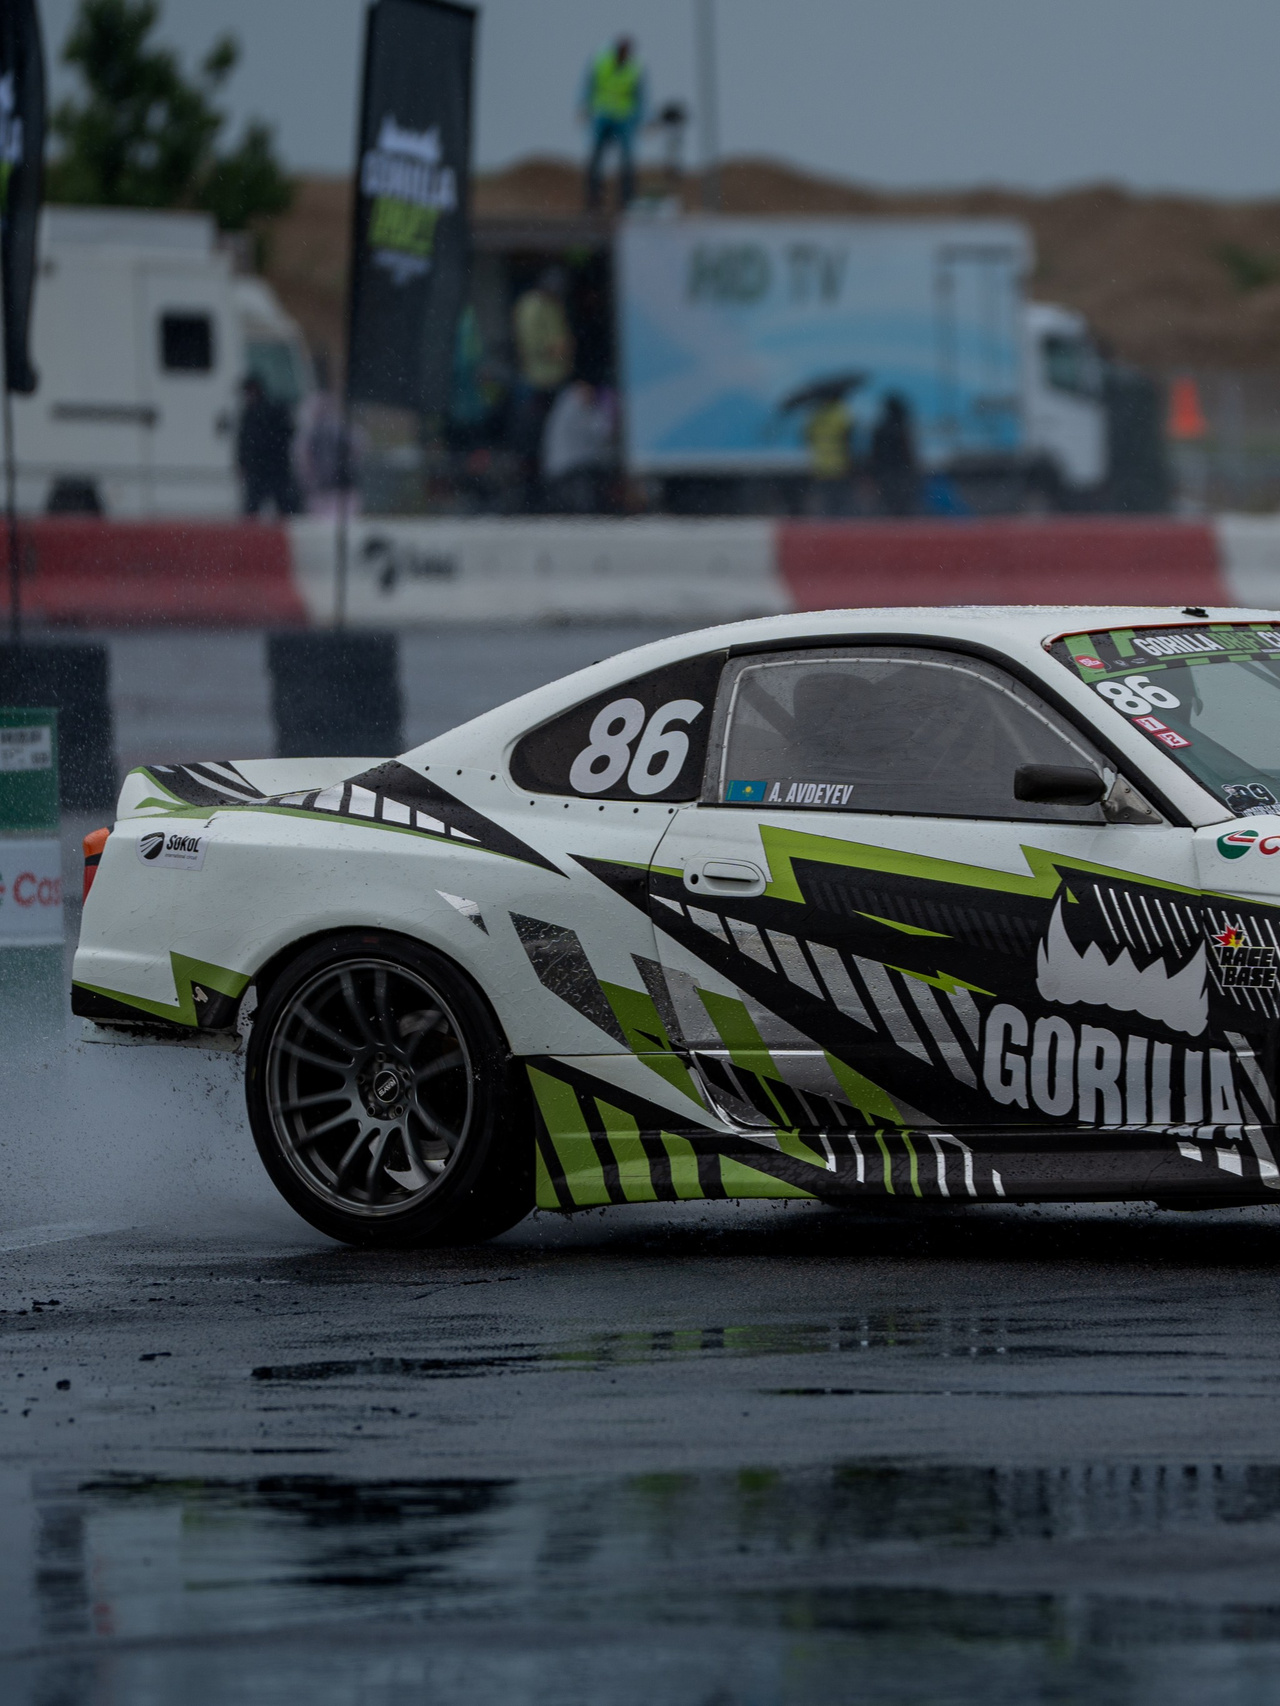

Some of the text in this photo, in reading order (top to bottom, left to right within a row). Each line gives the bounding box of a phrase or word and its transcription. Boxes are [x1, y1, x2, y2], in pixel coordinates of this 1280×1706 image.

[1133, 633, 1226, 657] GORILLA
[1206, 632, 1272, 651] DRIFT
[1096, 675, 1181, 716] 86
[568, 697, 704, 795] 86
[768, 782, 855, 805] A. AVDEYEV
[166, 834, 202, 853] SOKOL
[1219, 947, 1275, 968] RACE
[1222, 967, 1277, 988] BASE
[983, 1003, 1245, 1141] GORILLA
